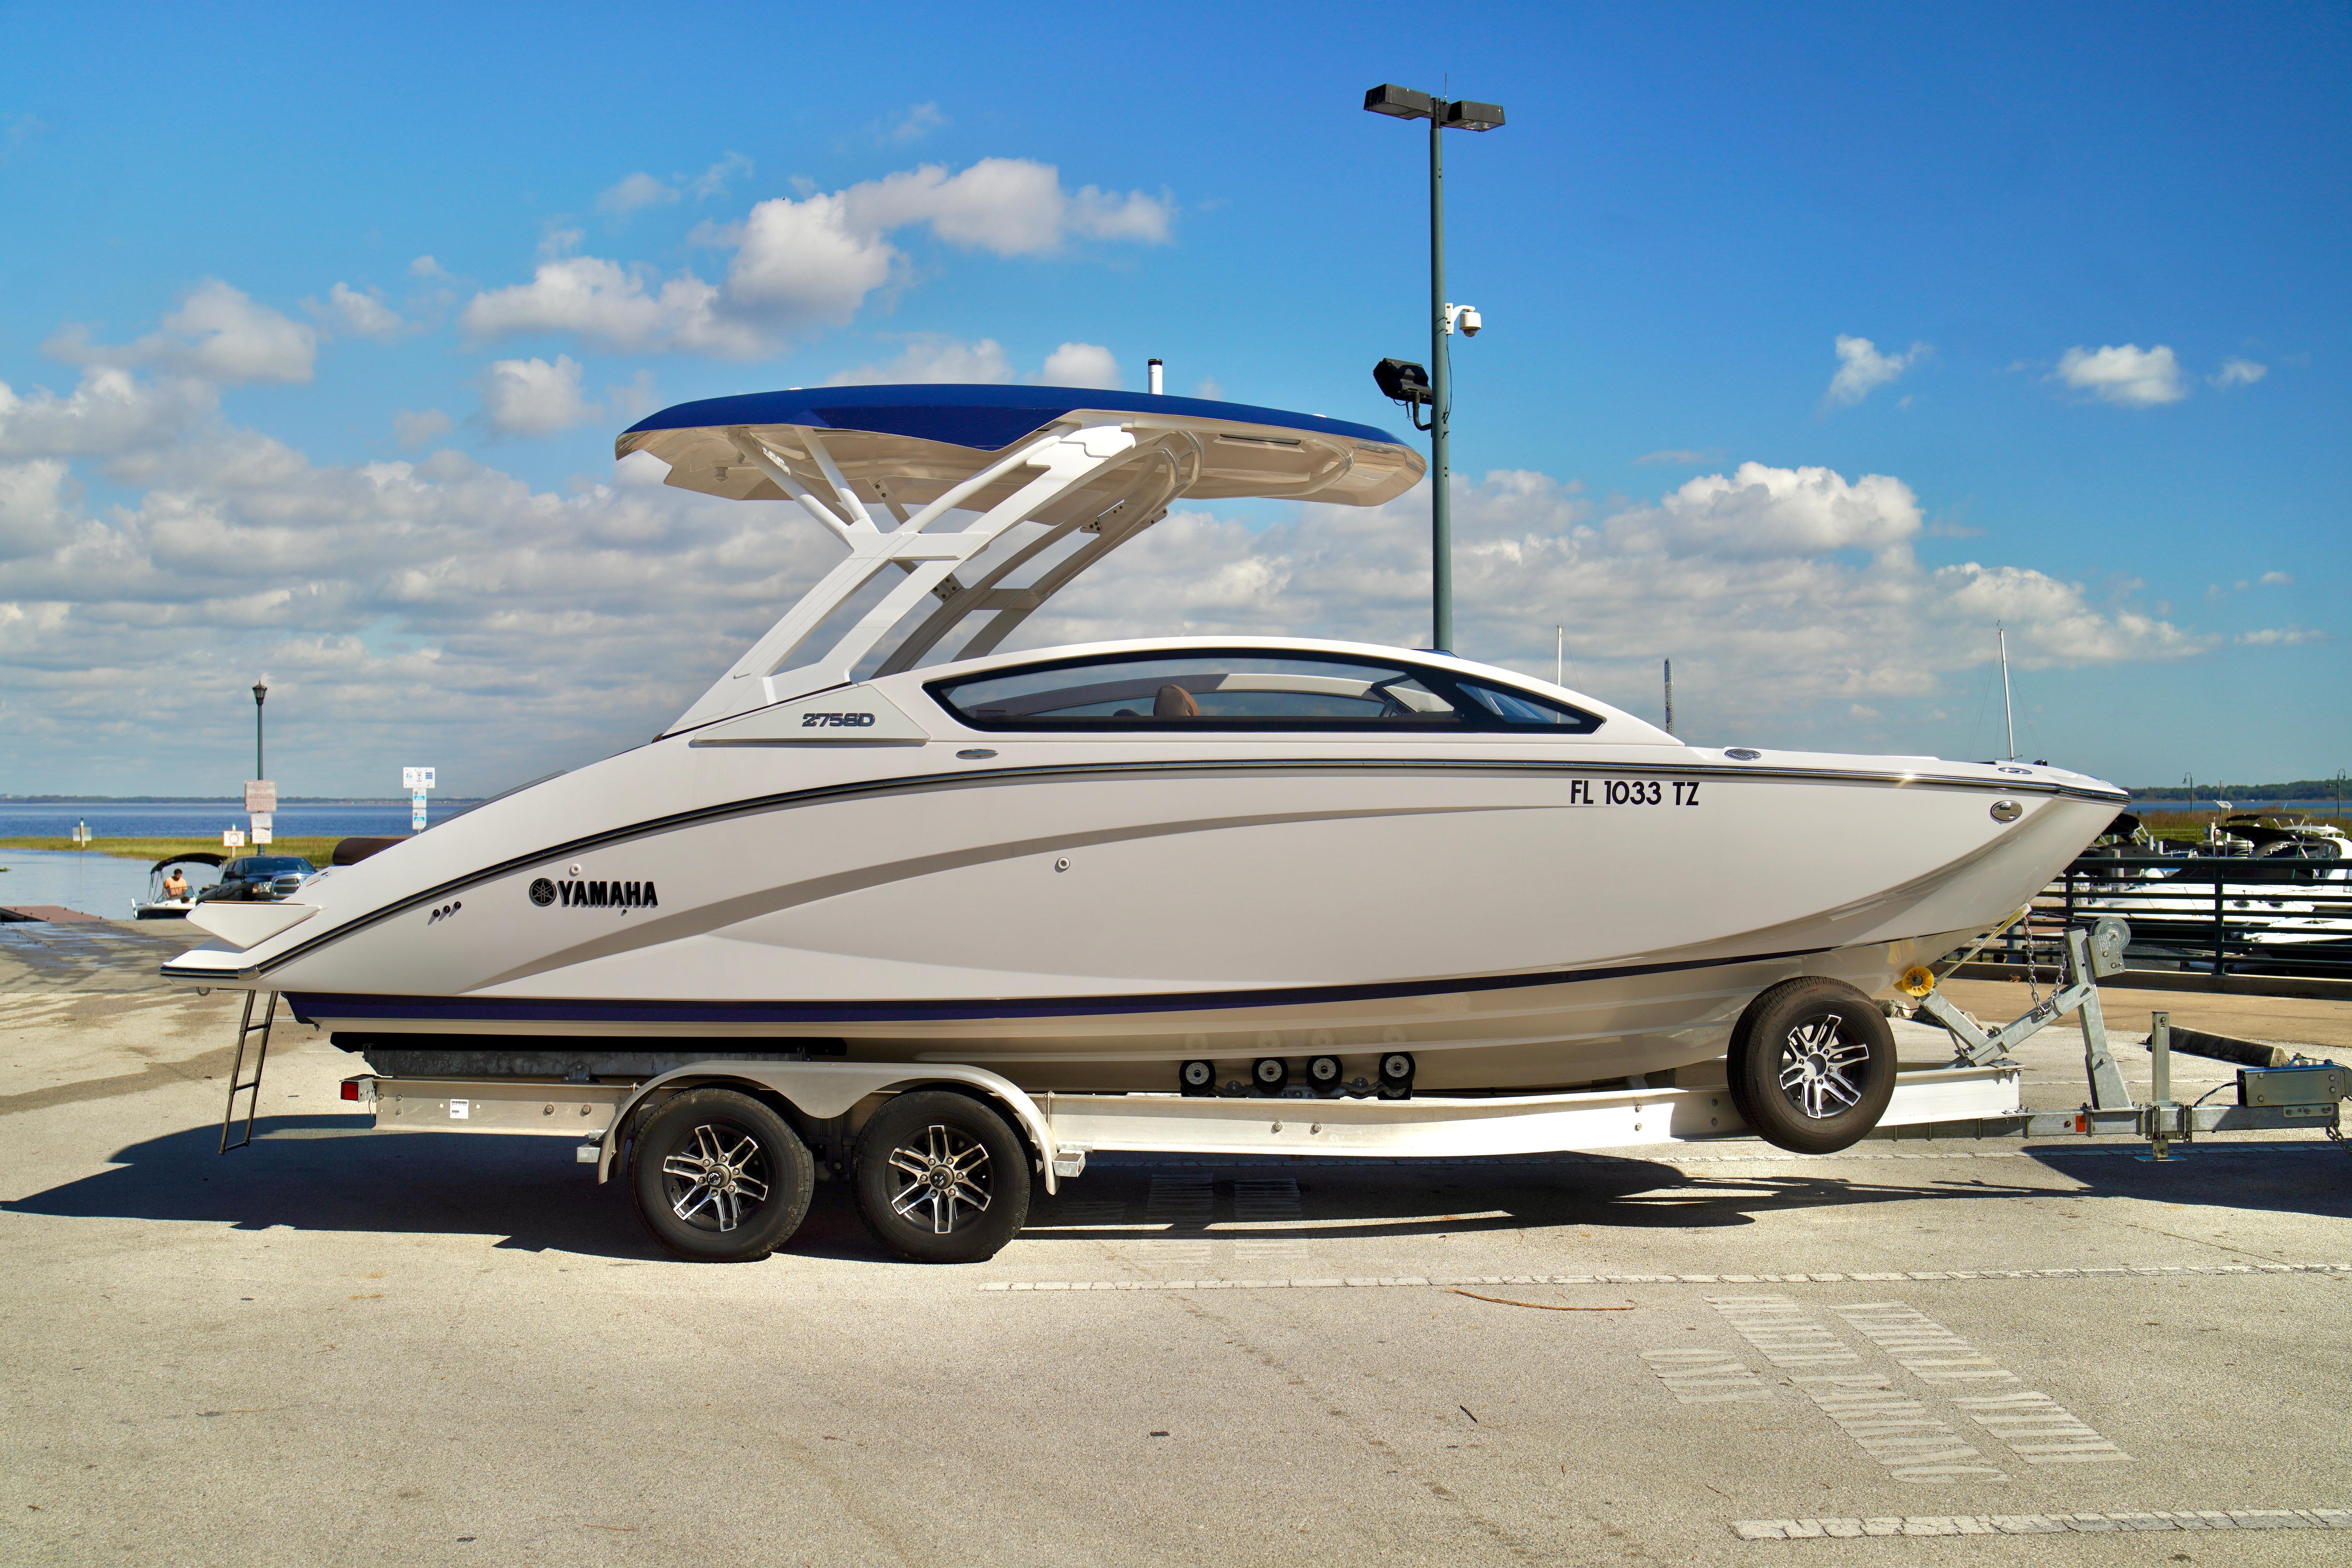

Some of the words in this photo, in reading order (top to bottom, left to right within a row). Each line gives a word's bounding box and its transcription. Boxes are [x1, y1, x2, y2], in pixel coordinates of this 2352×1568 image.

[802, 712, 876, 727] 275SD
[1571, 780, 1594, 804] FL
[1604, 781, 1661, 805] 1033
[1672, 781, 1700, 806] TZ
[557, 880, 658, 906] YAMAHA
[1787, 1373, 2014, 1484] PARKING
